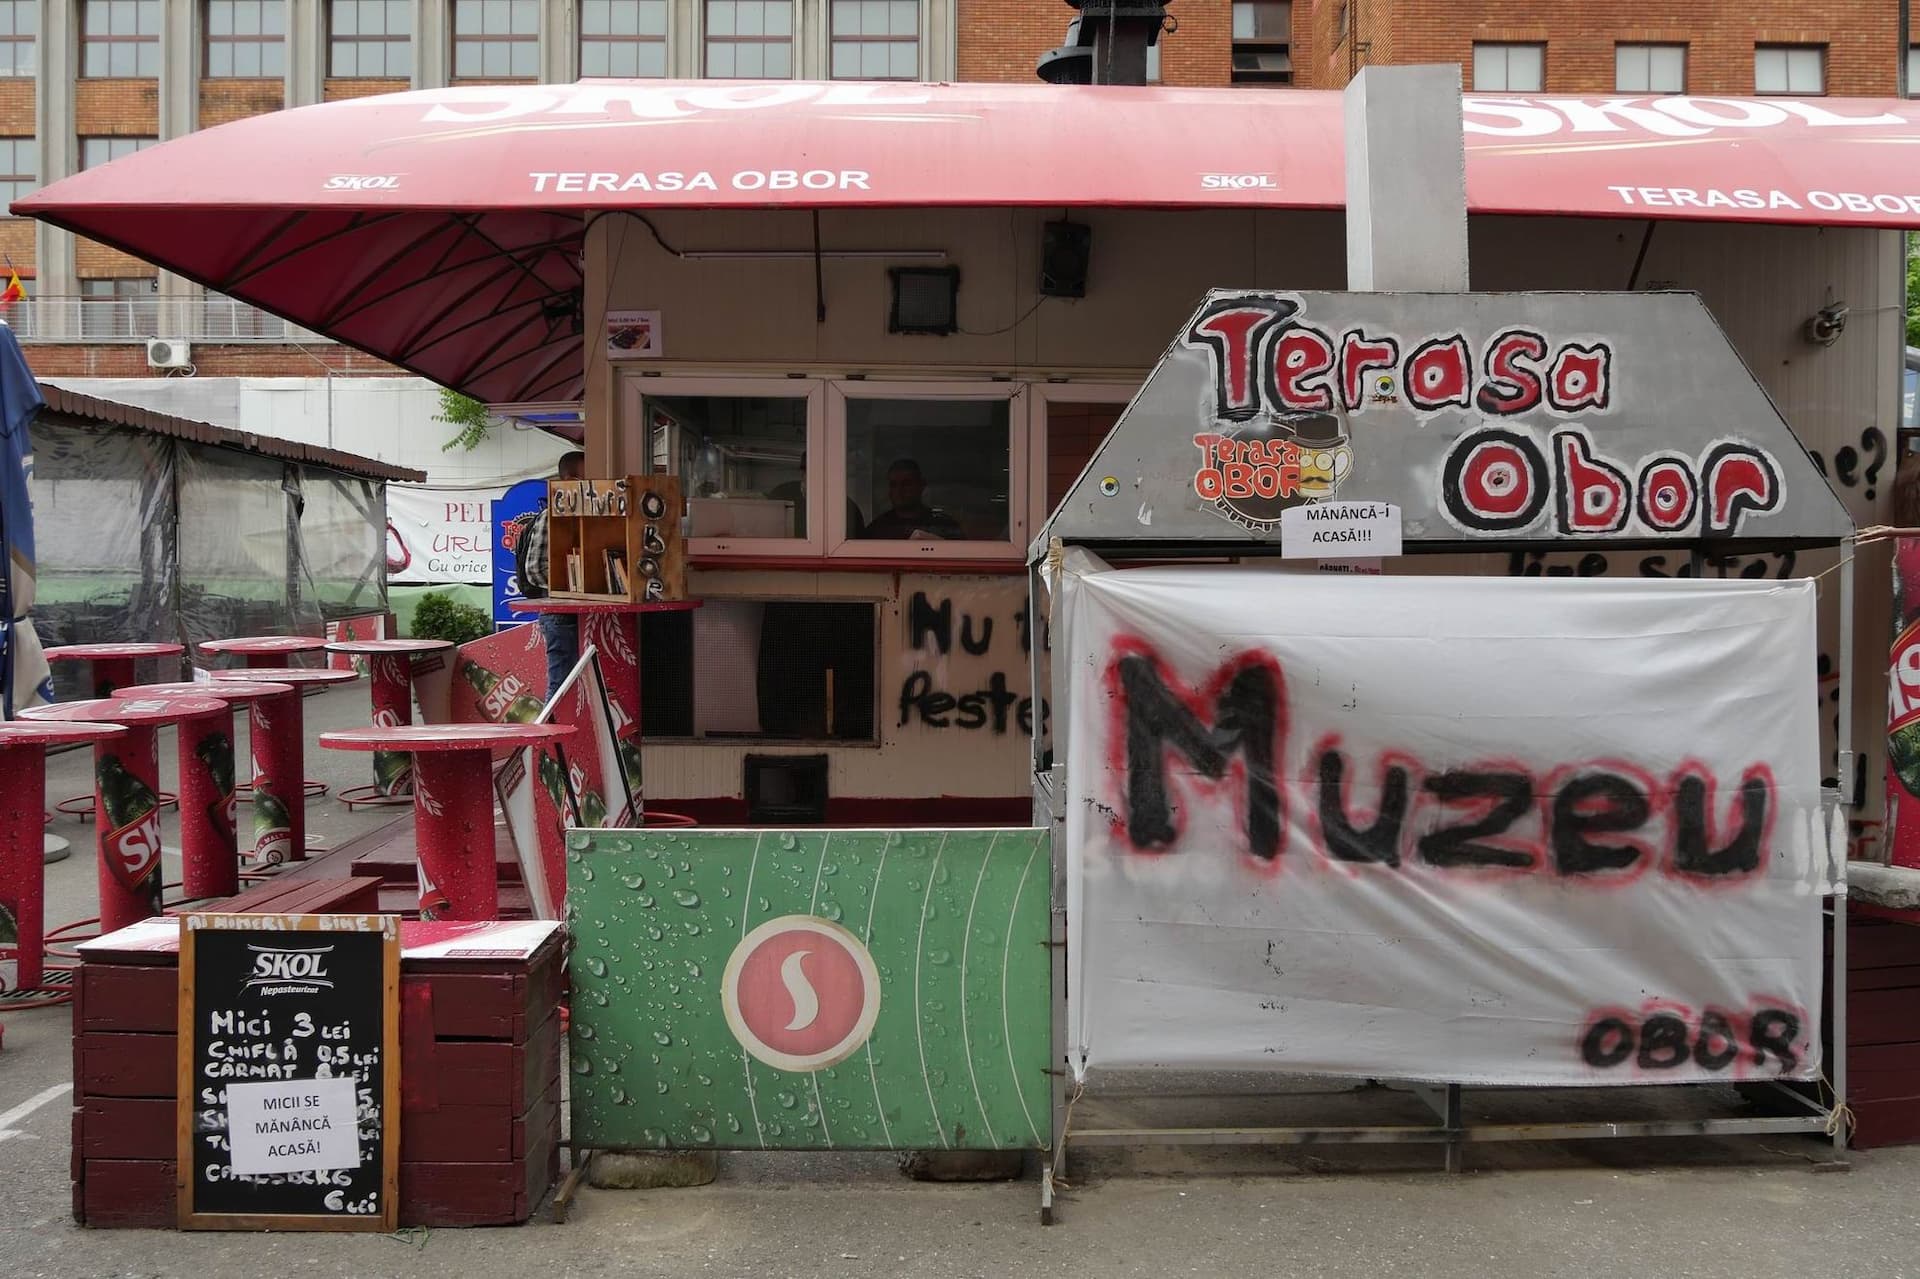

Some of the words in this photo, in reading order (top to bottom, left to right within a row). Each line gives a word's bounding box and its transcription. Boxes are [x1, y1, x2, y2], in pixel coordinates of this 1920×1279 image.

[1463, 96, 1908, 137] SKOL
[323, 175, 401, 190] SKOL
[529, 172, 719, 192] TERASA
[731, 169, 872, 190] OBOR
[1201, 174, 1277, 189] SKOL
[1607, 186, 1802, 210] TERASA
[1188, 294, 1613, 424] Terasa
[1193, 432, 1301, 470] Terasa
[1194, 462, 1301, 500] OBOR
[1442, 426, 1780, 538] Obor
[1312, 529, 1372, 543] ACASĂ!!!
[428, 558, 448, 573] Cu
[453, 559, 488, 573] orice
[911, 592, 993, 655] Nu
[485, 675, 525, 719] SKOL
[1108, 640, 1772, 878] Muzeu
[253, 953, 328, 979] SKOL
[260, 985, 320, 996] Nepasteurizat
[292, 1012, 316, 1037] 3
[1580, 1006, 1800, 1076] OBOR
[317, 1044, 350, 1065] 0,5
[263, 1097, 300, 1110] MICII
[304, 1095, 320, 1107] SE
[255, 1115, 332, 1134] MĂNÂNCĂ
[268, 1138, 321, 1157] ACASĂ!
[323, 1190, 345, 1211] 6
